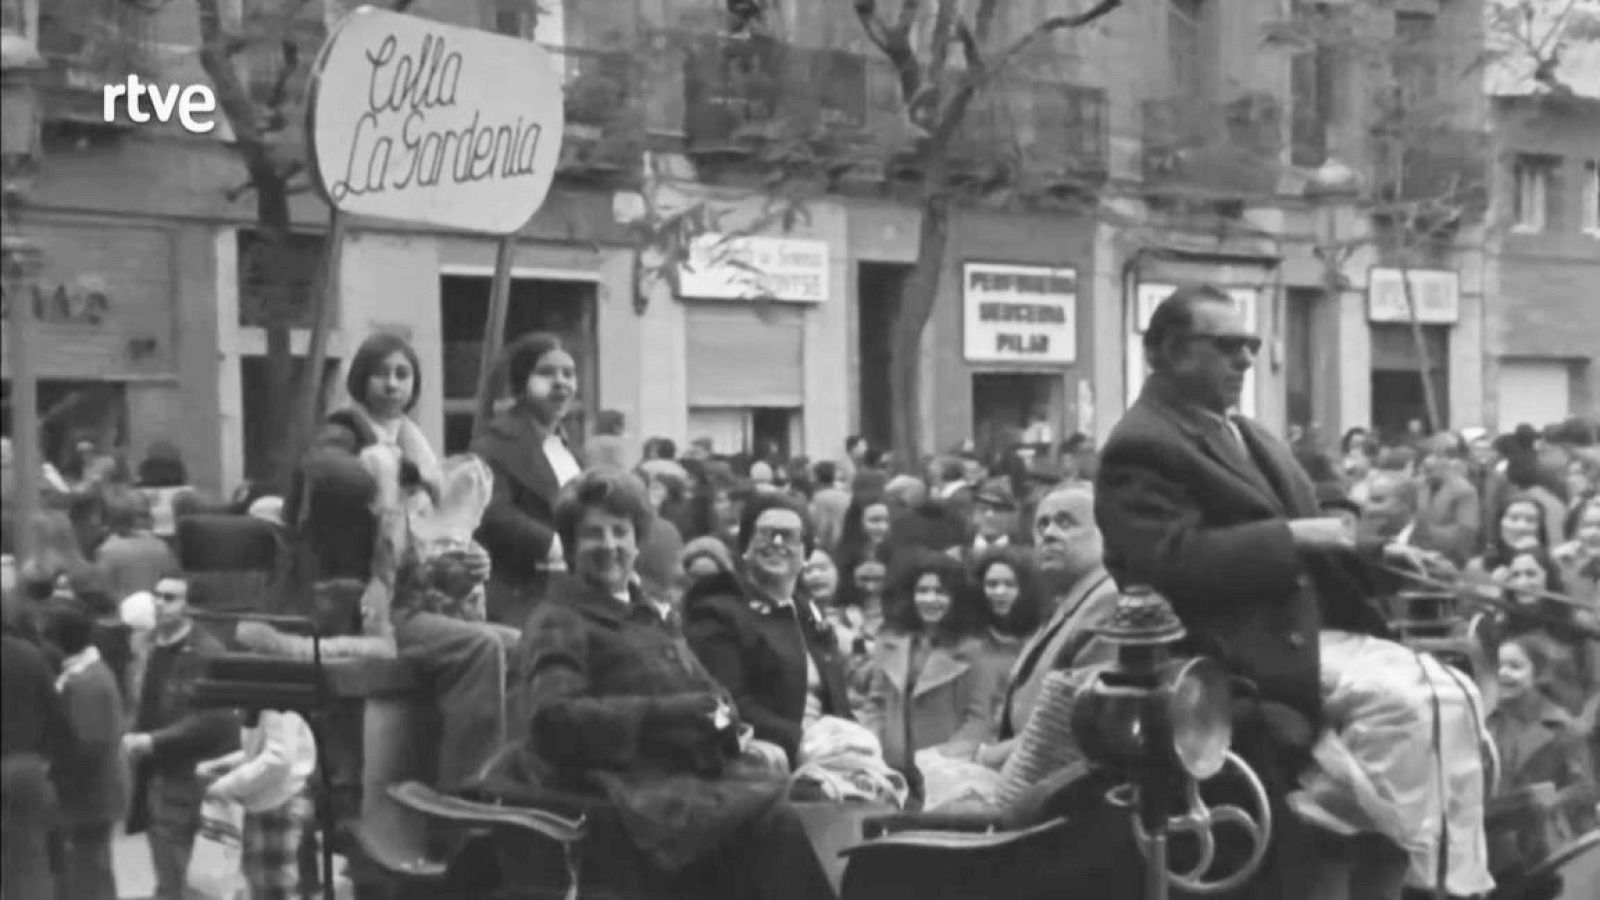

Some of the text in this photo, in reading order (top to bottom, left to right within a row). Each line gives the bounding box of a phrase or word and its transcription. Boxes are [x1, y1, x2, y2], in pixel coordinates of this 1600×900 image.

[365, 33, 462, 113] Colla
[331, 108, 542, 202] La Gardenia
[995, 332, 1050, 353] PILAR
